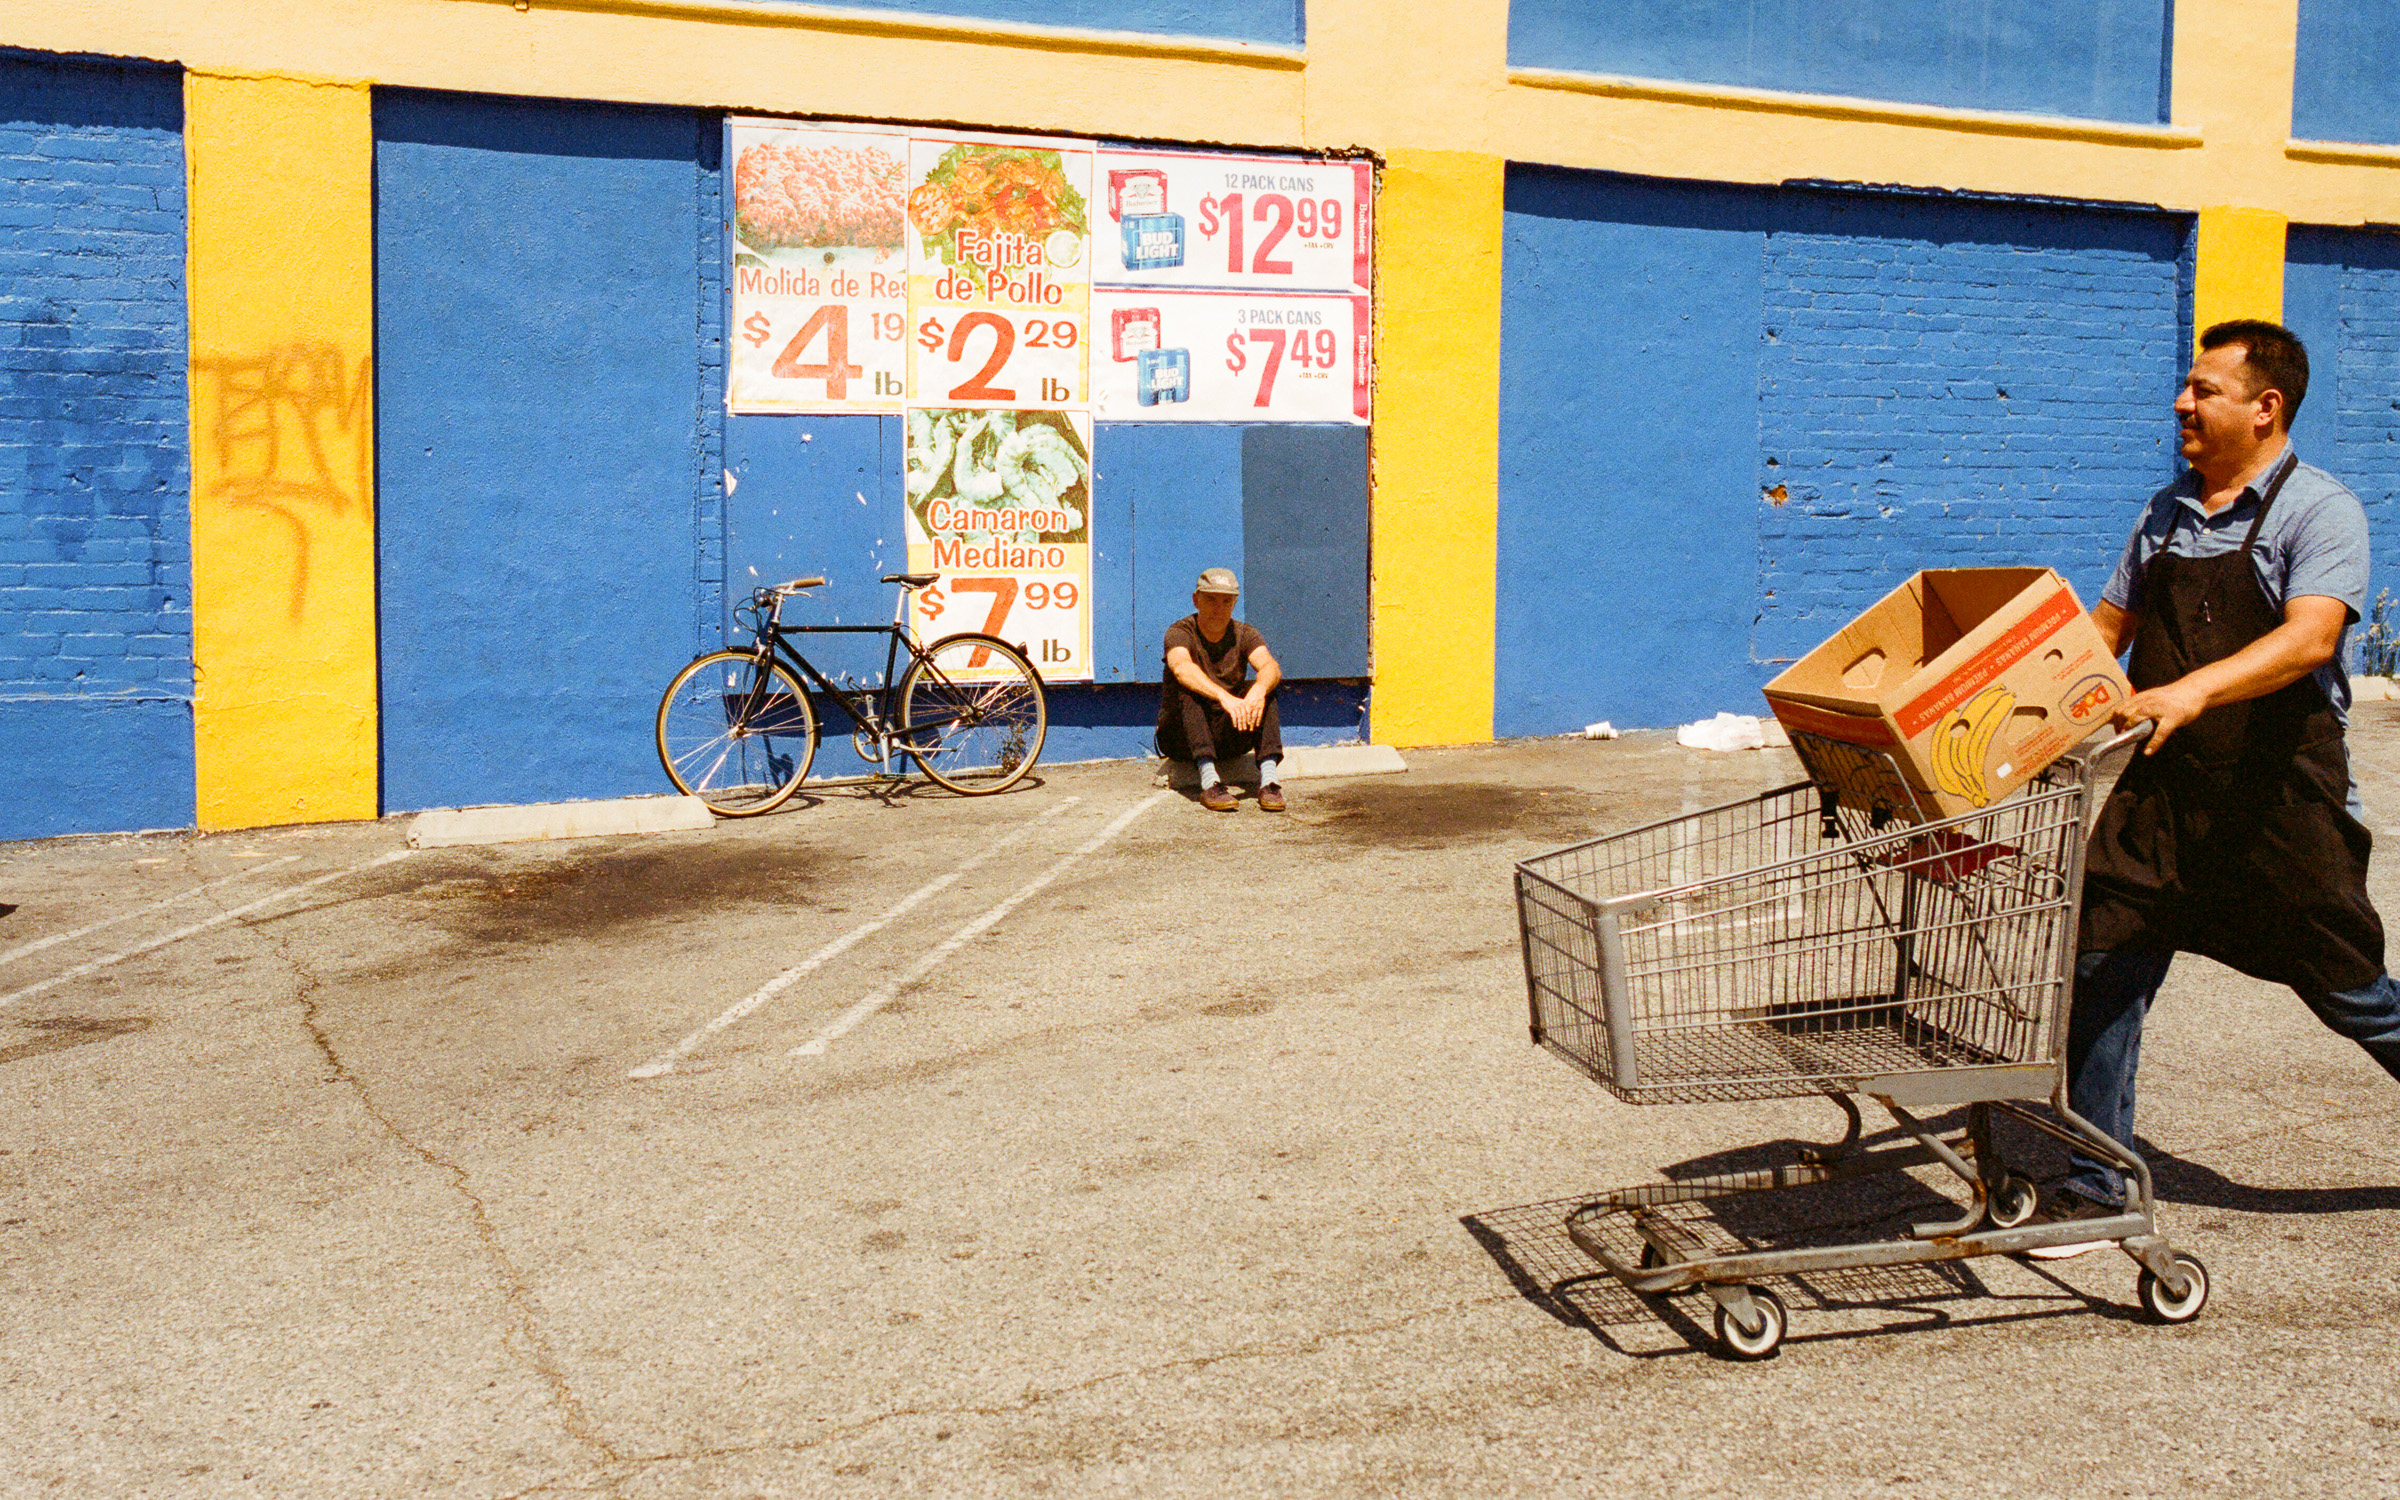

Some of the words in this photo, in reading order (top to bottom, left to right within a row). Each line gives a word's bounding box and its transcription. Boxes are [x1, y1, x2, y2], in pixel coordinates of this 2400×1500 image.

[1225, 173, 1238, 189] 12
[1242, 174, 1275, 190] PACK
[1279, 176, 1314, 192] CANS
[1141, 231, 1173, 246] BUD
[1359, 203, 1369, 255] Budweiser
[956, 231, 1042, 271] Fajita
[1136, 243, 1179, 260] LIGHT
[740, 267, 820, 298] Molida
[830, 268, 860, 298] de
[936, 268, 973, 300] de
[987, 271, 1063, 305] Pollo
[1238, 309, 1246, 324] 3
[1250, 309, 1283, 325] PACK
[1287, 310, 1322, 325] CANS
[1154, 368, 1179, 378] BUD
[1358, 335, 1368, 386] Budweiser
[875, 371, 903, 396] lb
[1041, 377, 1070, 402] lb
[1150, 376, 1184, 390] LIGHT
[929, 500, 1068, 531] Camaron
[933, 537, 1065, 569] Mediano
[2026, 611, 2062, 642] PREMIUM
[1042, 638, 1072, 662] lb
[1951, 666, 1989, 698] PREMIUM
[2069, 684, 2111, 719] Dole
